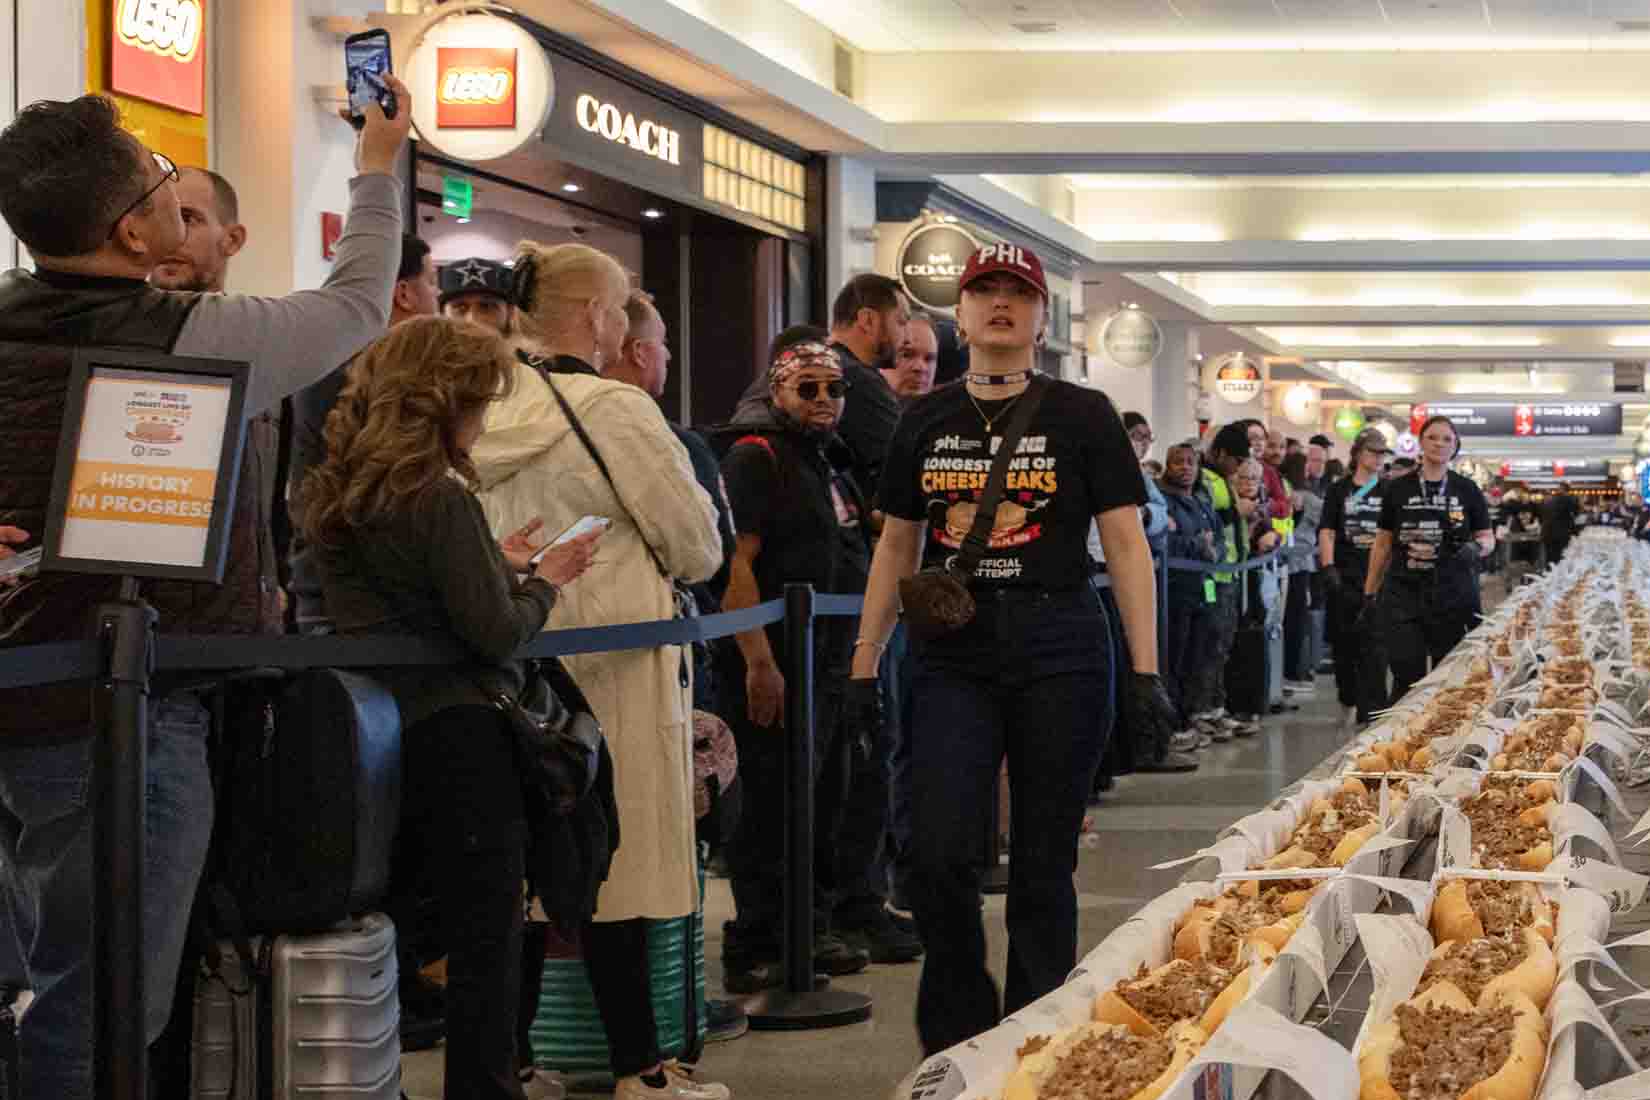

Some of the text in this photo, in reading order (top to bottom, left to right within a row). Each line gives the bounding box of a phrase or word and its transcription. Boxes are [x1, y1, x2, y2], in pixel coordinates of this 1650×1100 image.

[119, 0, 201, 60] LEGO
[441, 69, 511, 103] LEGO
[576, 94, 681, 165] COACH
[979, 243, 1032, 270] PHL
[923, 457, 993, 472] LONGEST
[1032, 457, 1057, 470] OF
[98, 472, 193, 496] HISTORY
[71, 494, 97, 510] IN
[975, 567, 1023, 579] TTEMPT
[979, 558, 1023, 569] FFICIAL
